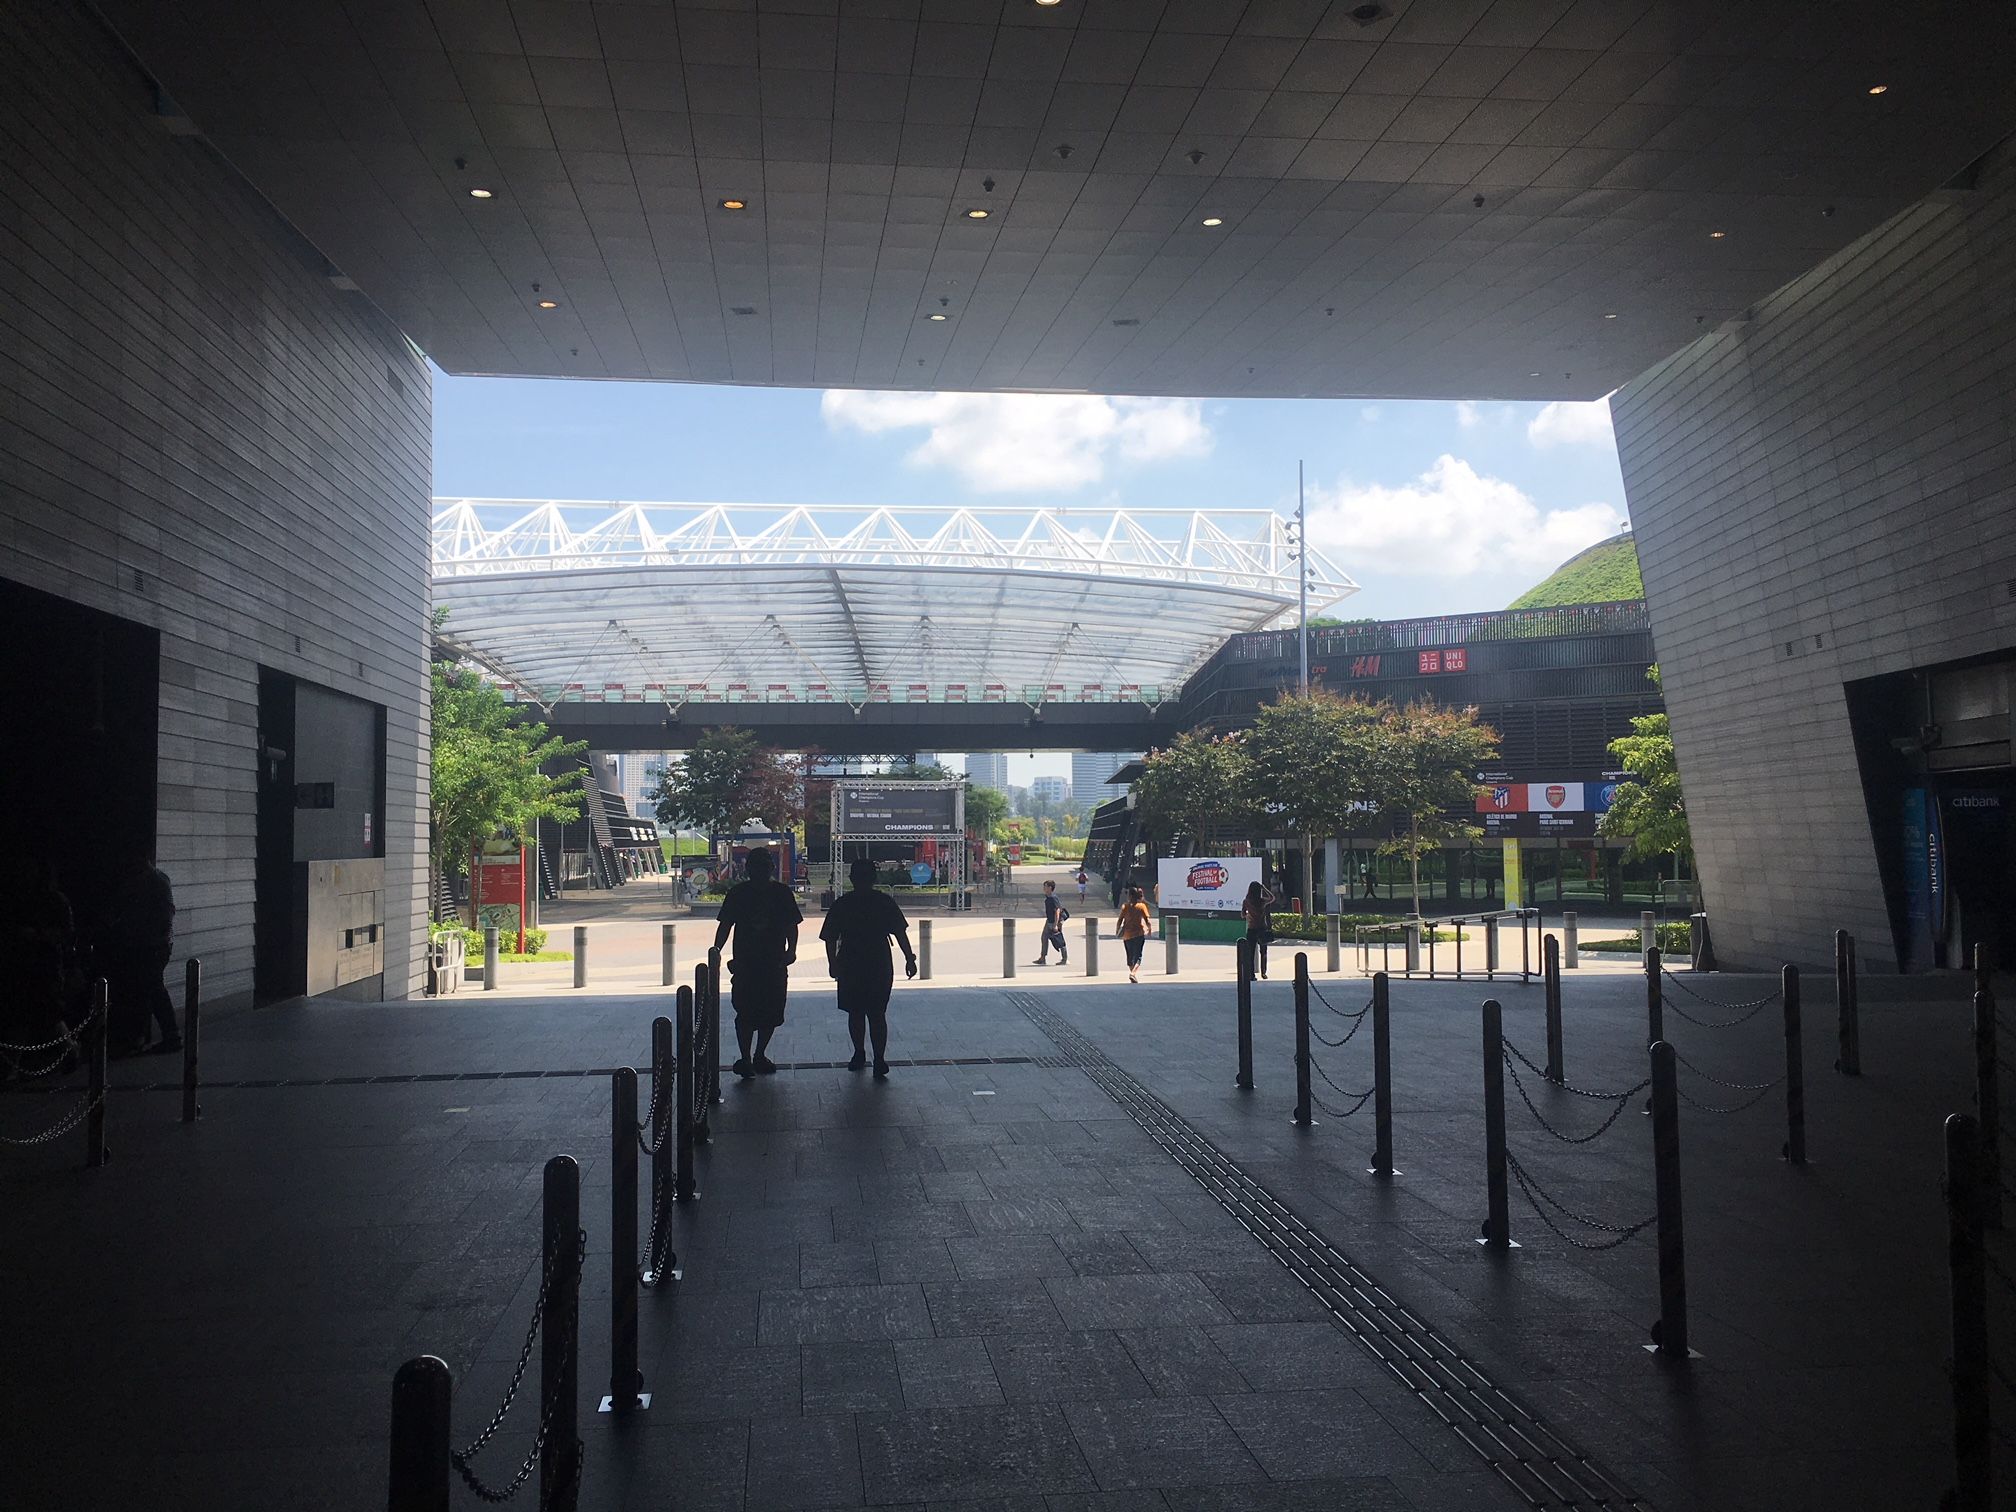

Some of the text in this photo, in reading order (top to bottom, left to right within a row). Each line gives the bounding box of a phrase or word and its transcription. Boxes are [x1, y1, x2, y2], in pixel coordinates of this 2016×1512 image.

[1446, 652, 1462, 661] UNI
[1446, 660, 1463, 670] QLO
[1952, 795, 2000, 808] citibank
[1929, 833, 1939, 895] citibank
